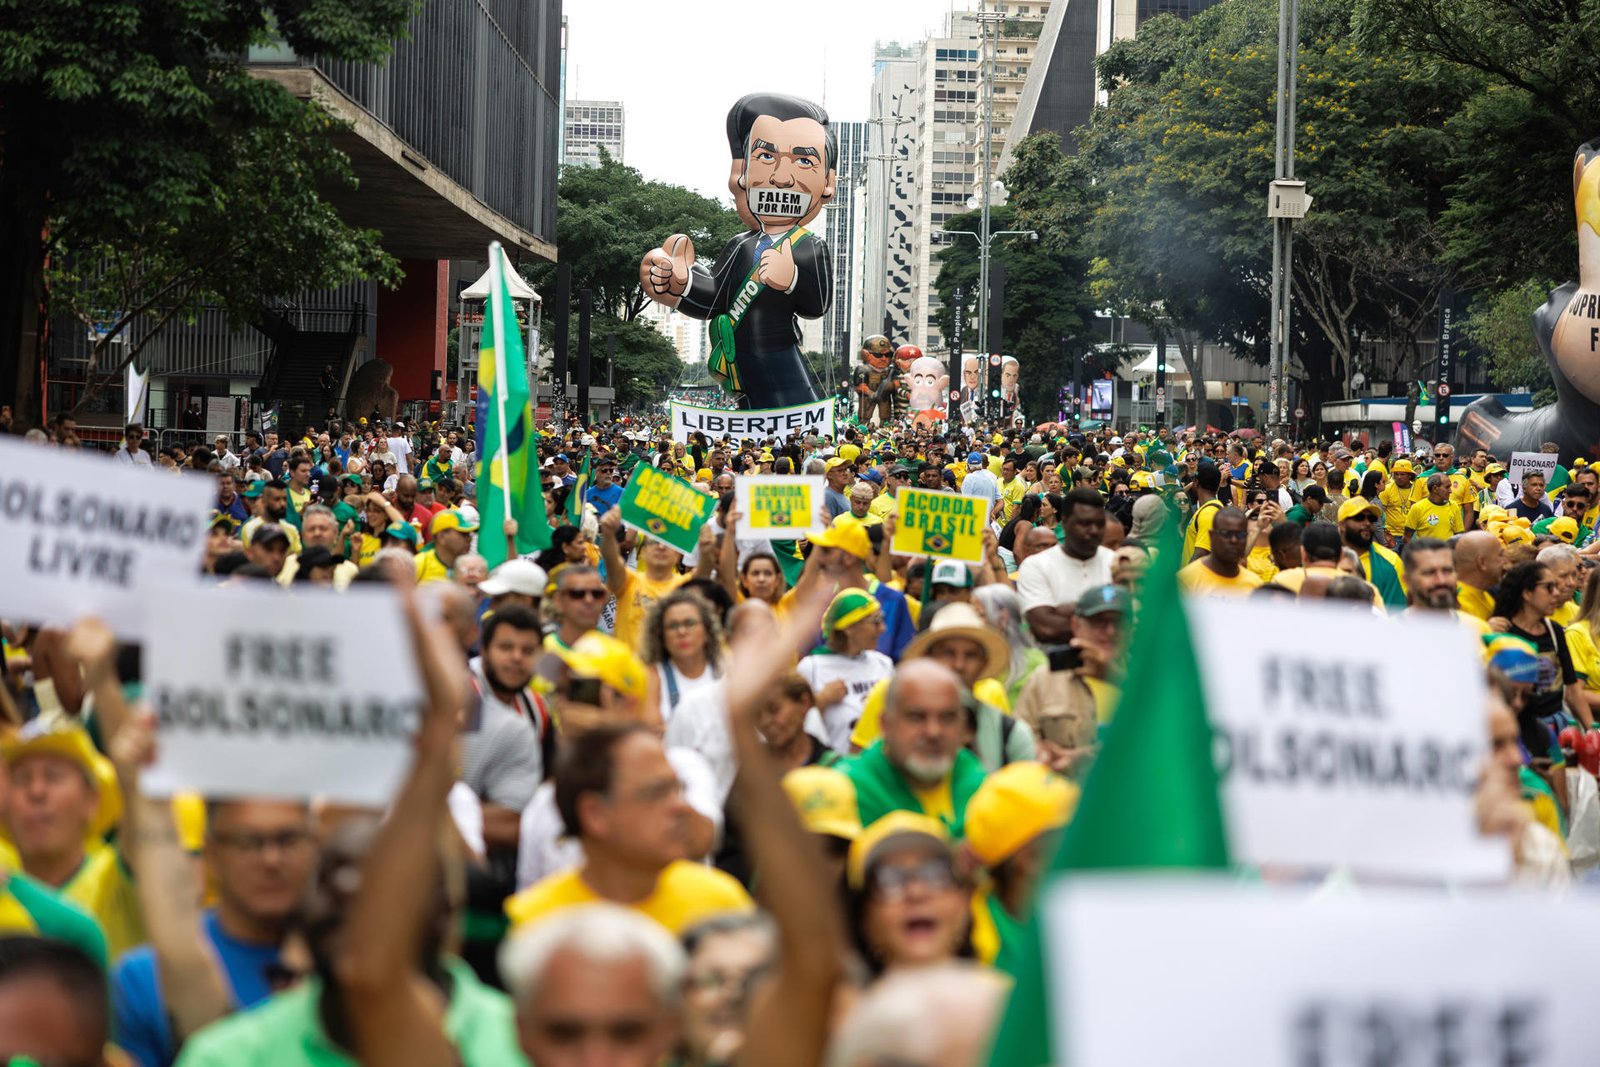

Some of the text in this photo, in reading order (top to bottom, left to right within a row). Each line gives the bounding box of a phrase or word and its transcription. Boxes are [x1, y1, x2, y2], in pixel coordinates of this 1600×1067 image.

[757, 203, 802, 215] POR MIM
[758, 191, 801, 205] FALEM
[729, 280, 759, 321] MITO
[953, 306, 961, 342] Pamplona
[1442, 308, 1451, 340] Branca
[1441, 343, 1449, 366] Casa
[681, 407, 826, 433] LIBERTEM
[1512, 458, 1556, 468] BOLSONARO
[0, 479, 200, 549] OLSONARO
[634, 488, 693, 531] BRASIL
[755, 499, 806, 512] BRASIL
[904, 511, 976, 536] BRASIL
[28, 535, 134, 587] LIVRE
[224, 631, 336, 684] FREE
[1261, 653, 1388, 721] FREE
[1208, 724, 1477, 794] OLSONARO
[1286, 992, 1554, 1067] FREE
